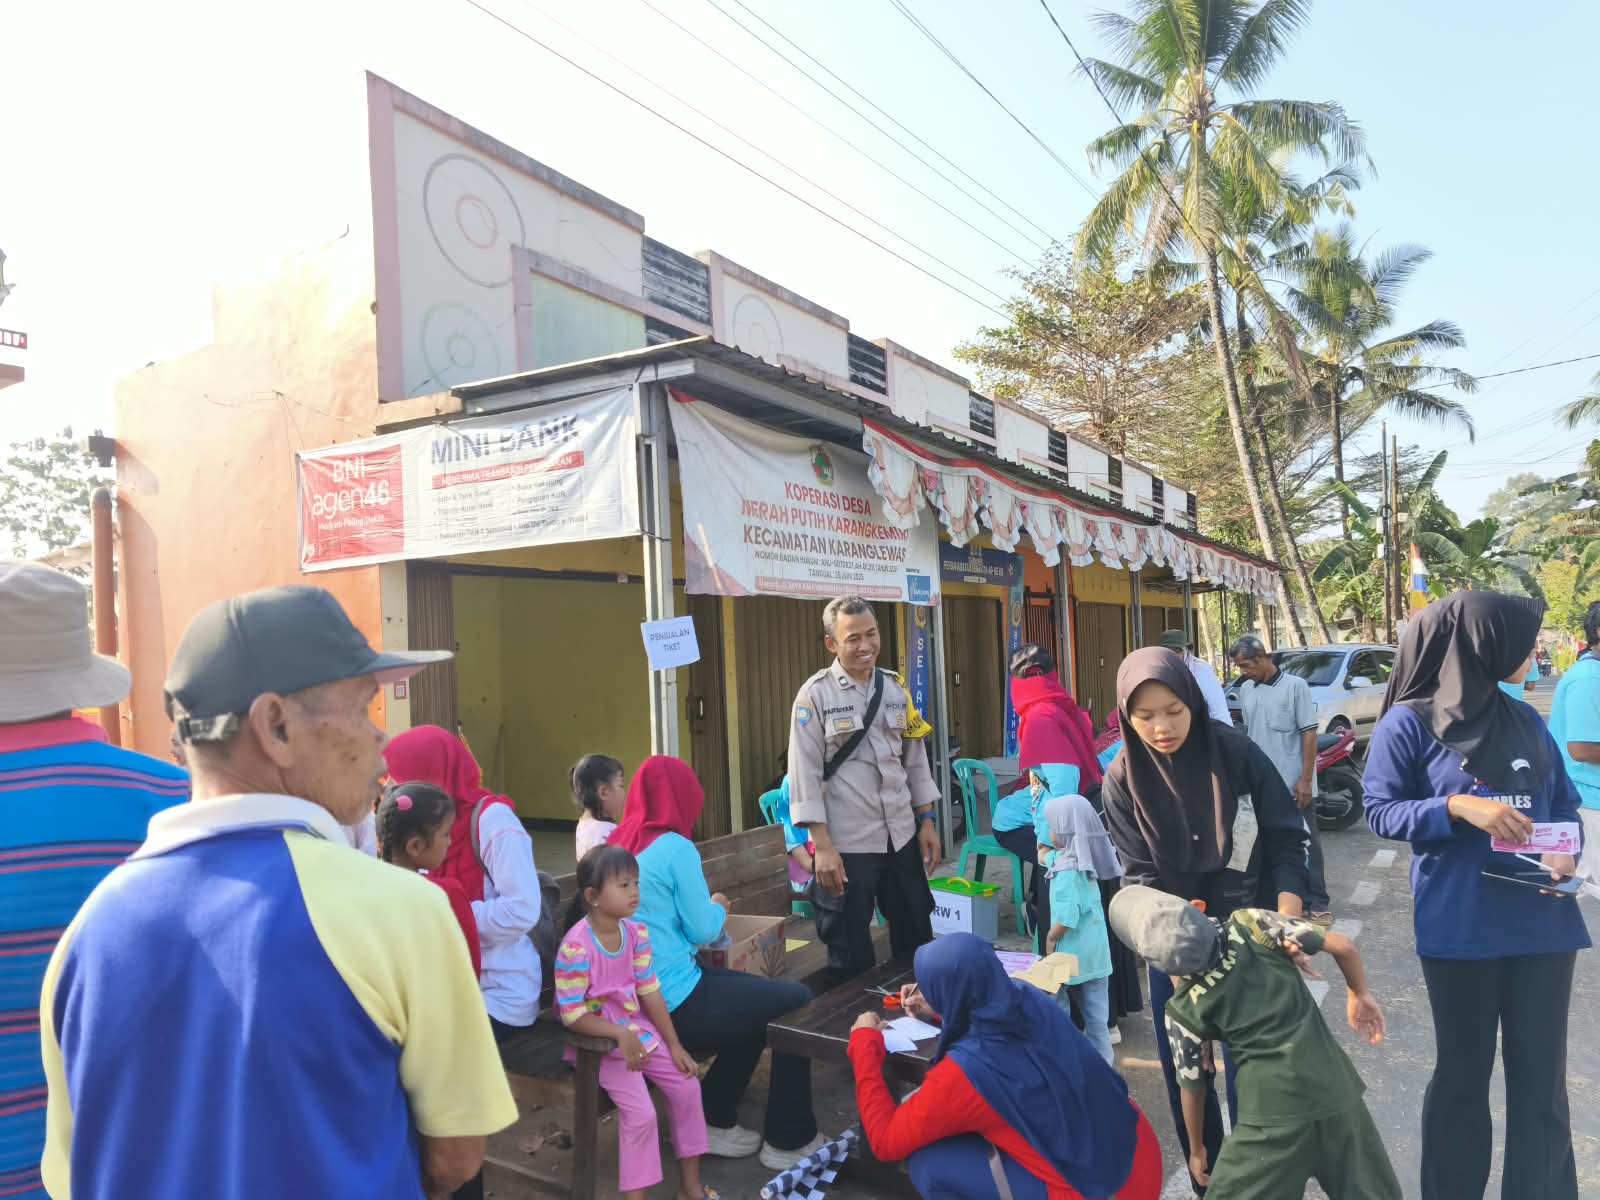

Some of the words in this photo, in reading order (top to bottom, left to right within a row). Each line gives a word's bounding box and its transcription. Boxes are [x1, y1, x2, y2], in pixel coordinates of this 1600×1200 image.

[432, 433, 489, 464] MINI
[500, 414, 578, 452] BANK
[333, 455, 366, 482] BNI
[312, 479, 389, 519] agen46
[784, 481, 841, 510] KOPERASI
[843, 495, 872, 517] DESA
[790, 507, 826, 530] PUTIH
[743, 524, 827, 555] KECAMATAN
[828, 537, 907, 563] KARANGLEWAS
[649, 628, 690, 641] PENJUALAN
[663, 641, 681, 652] TIKET
[933, 905, 951, 918] RW
[955, 909, 961, 920] 1
[1189, 925, 1245, 1005] ARMY
